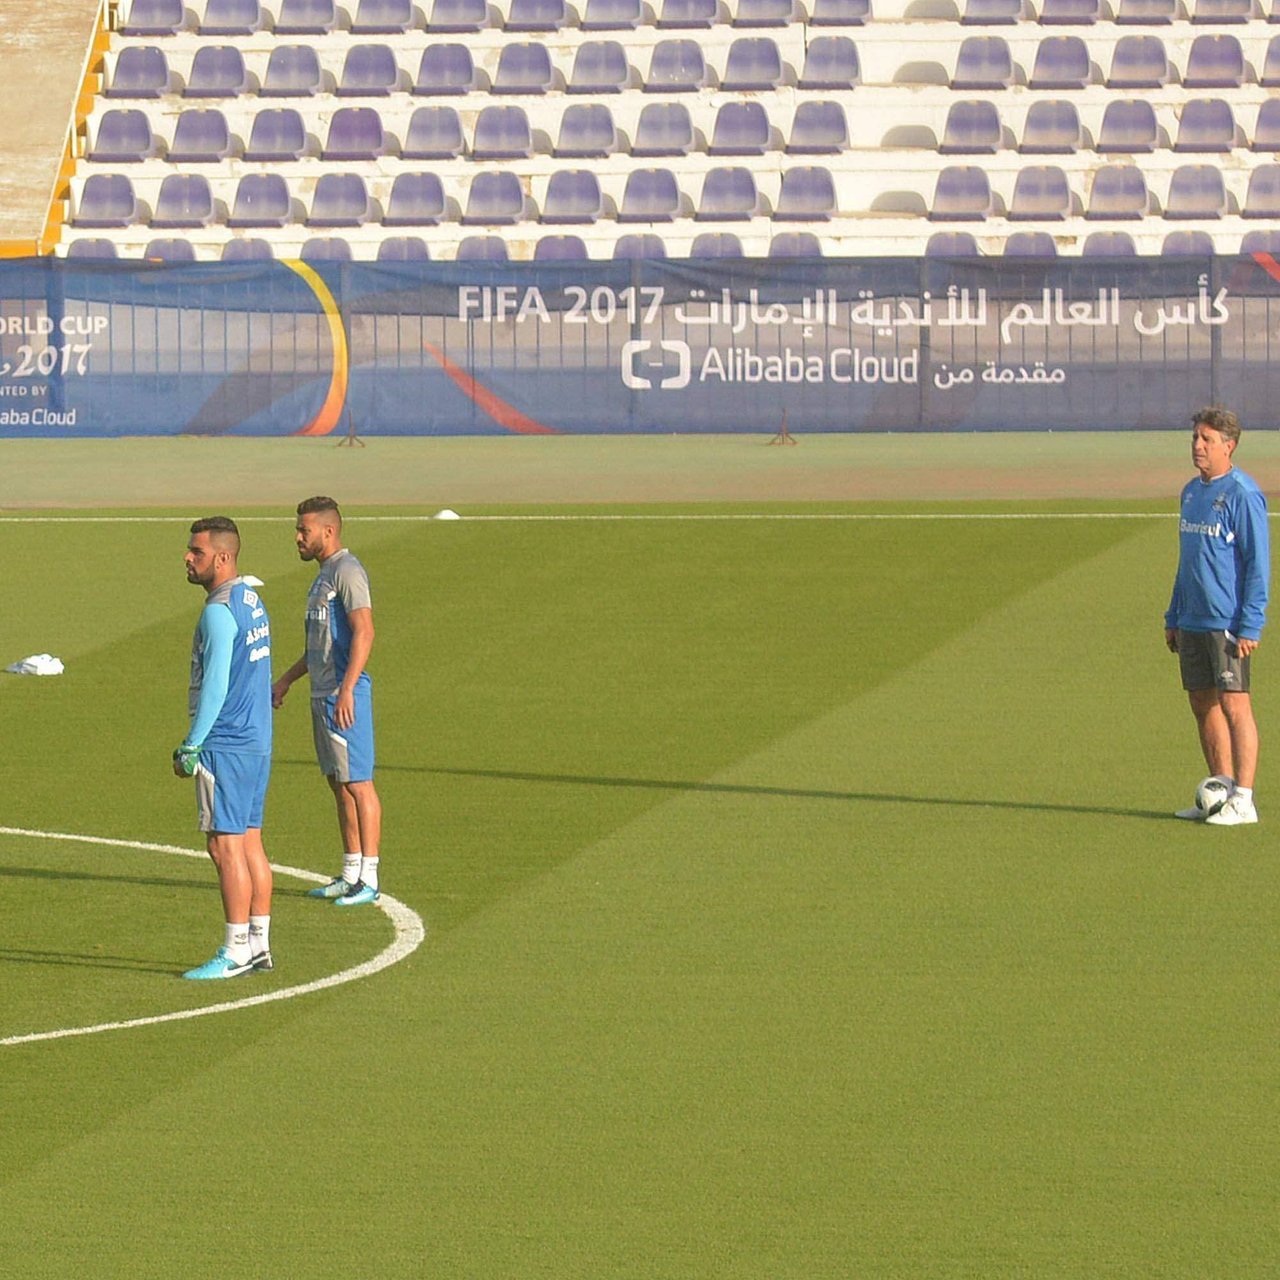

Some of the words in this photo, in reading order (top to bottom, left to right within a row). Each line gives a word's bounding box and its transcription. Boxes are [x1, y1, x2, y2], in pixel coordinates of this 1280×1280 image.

[458, 286, 551, 323] FIFA
[563, 286, 665, 325] 2017
[675, 287, 837, 339] الإمارات
[851, 284, 987, 336] للأندية
[1000, 287, 1119, 344] العالم
[1133, 273, 1231, 336] كأس
[60, 316, 108, 335] CUP
[11, 342, 92, 378] 2017
[699, 347, 824, 383] Alibaba
[830, 347, 918, 384] Cloud
[934, 363, 974, 389] من
[981, 361, 1067, 386] مقدمة
[31, 385, 47, 396] BY
[32, 408, 76, 426] Cloud
